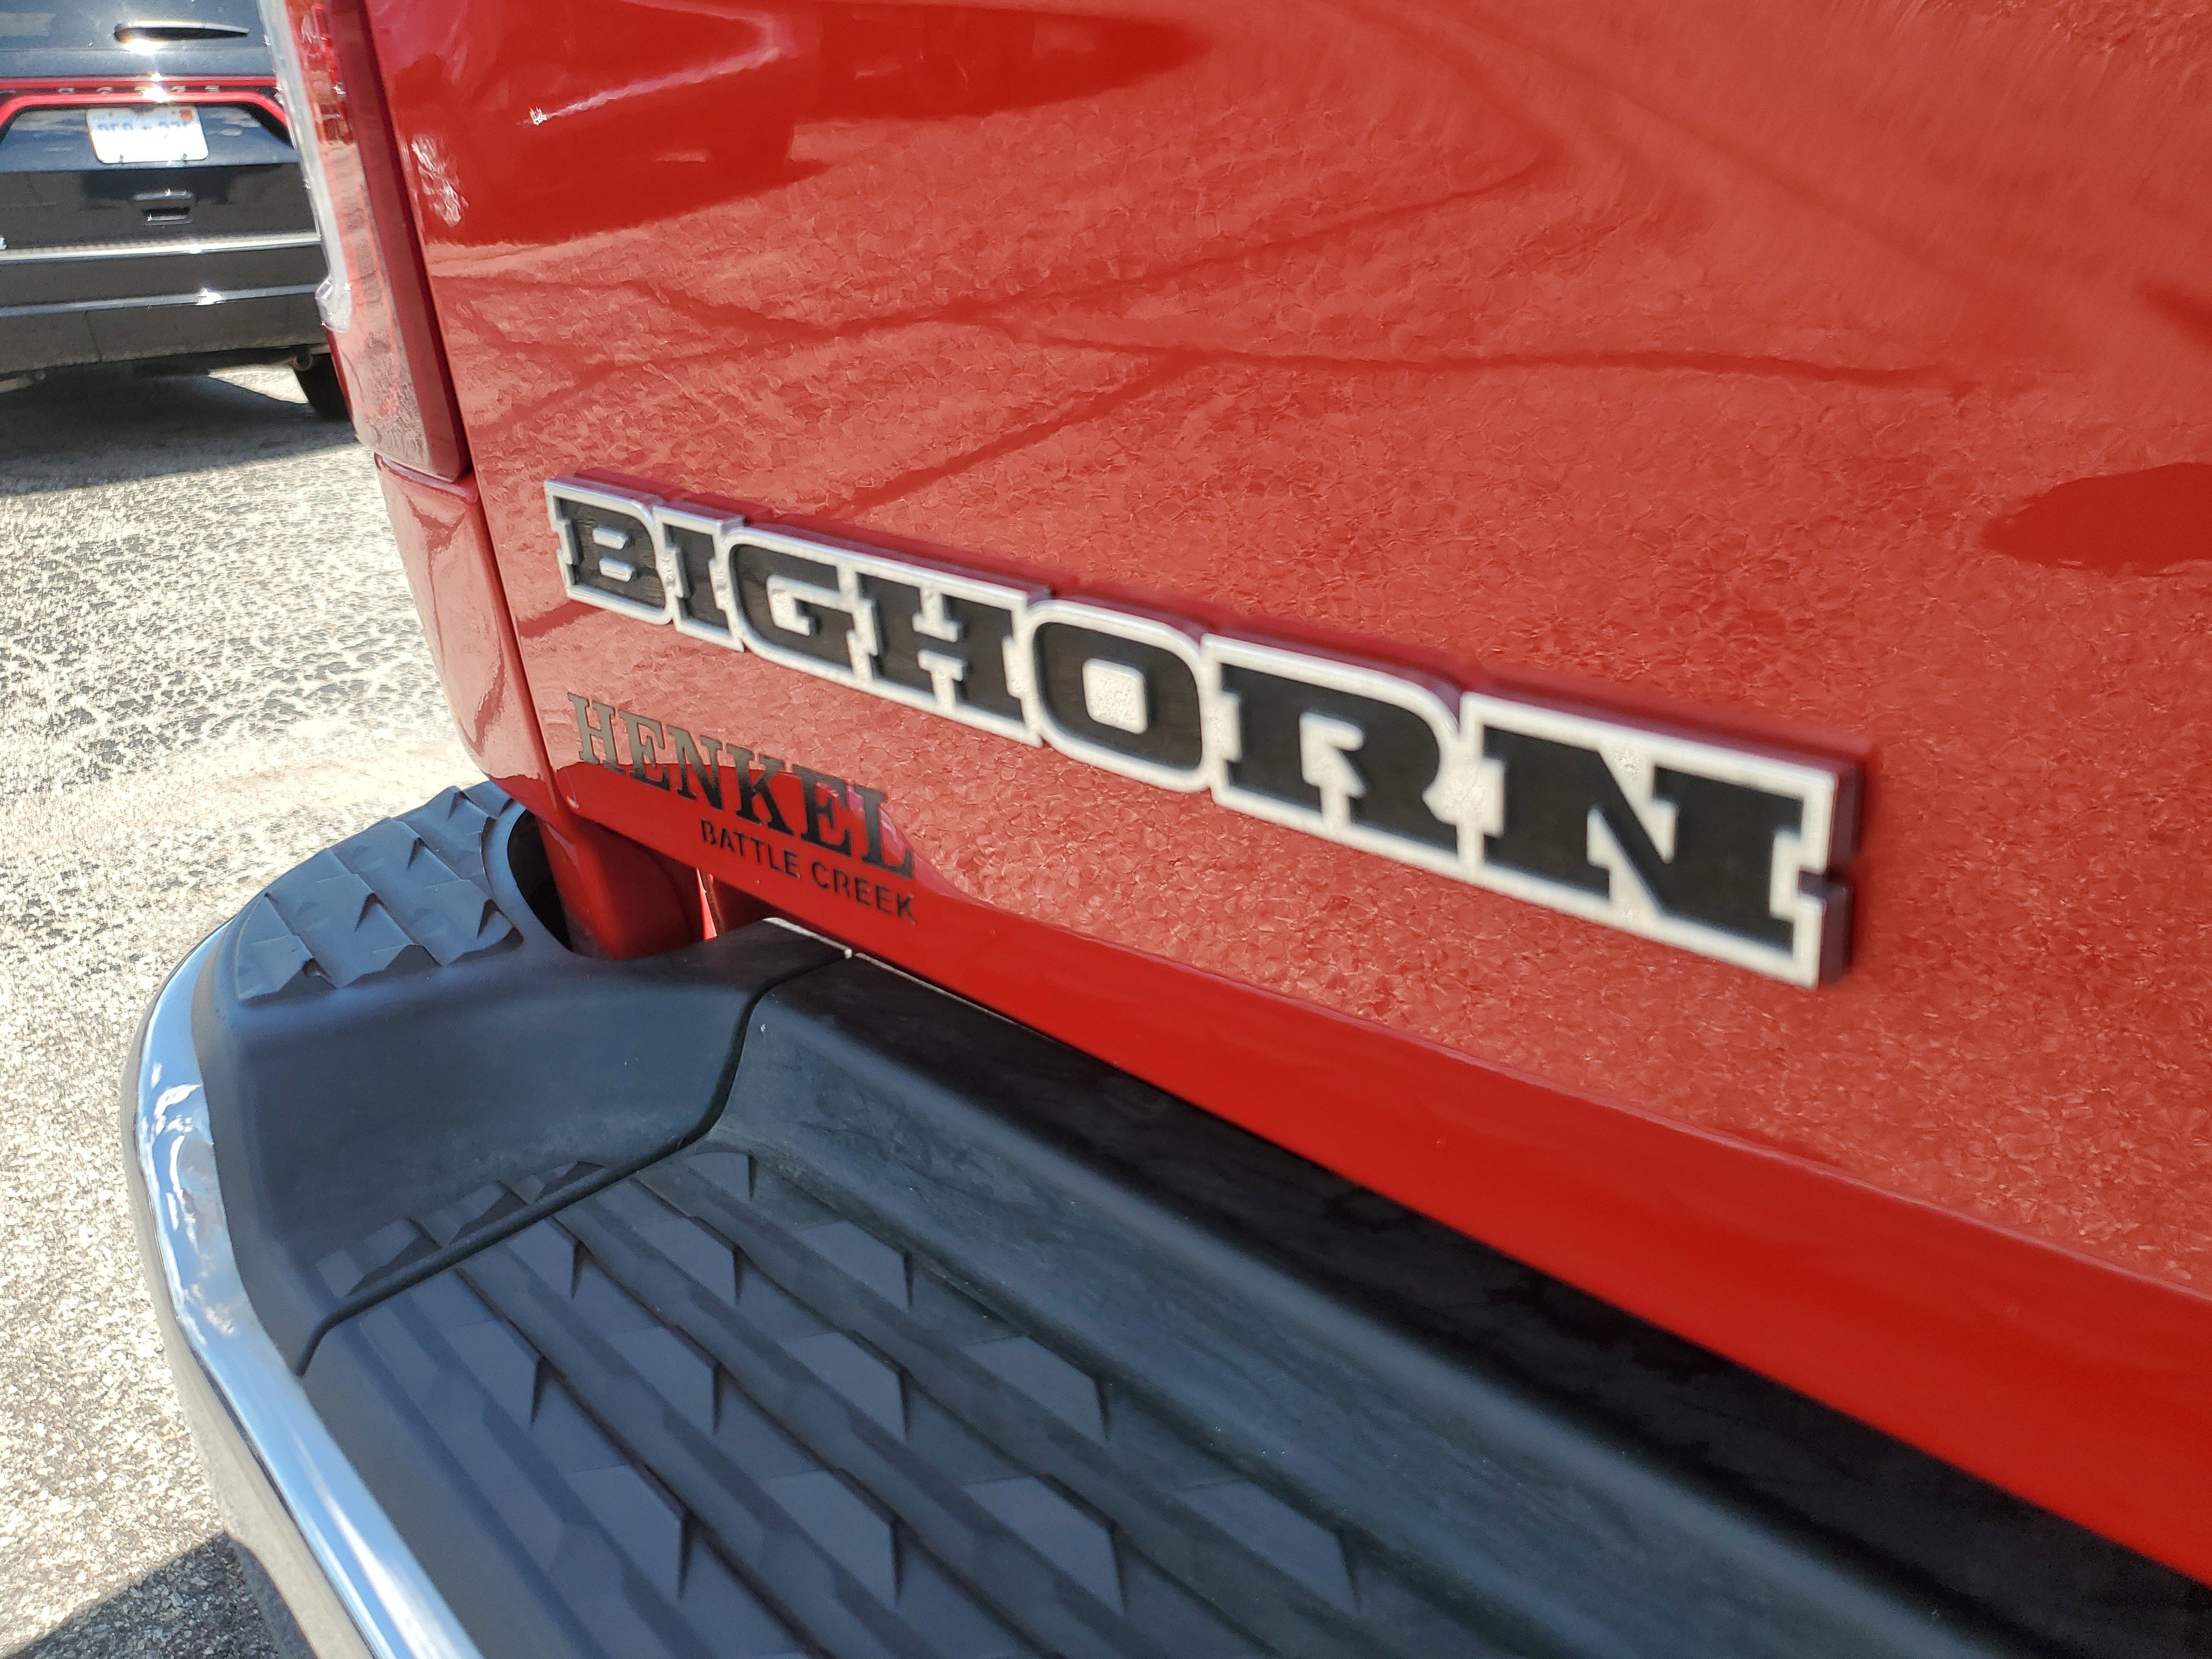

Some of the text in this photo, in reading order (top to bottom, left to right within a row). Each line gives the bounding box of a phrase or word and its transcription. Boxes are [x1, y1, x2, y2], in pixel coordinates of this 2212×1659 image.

[544, 481, 1837, 989] BIGHORN
[567, 692, 915, 879] HENKEL
[701, 819, 916, 926] BATTLE CREEK
